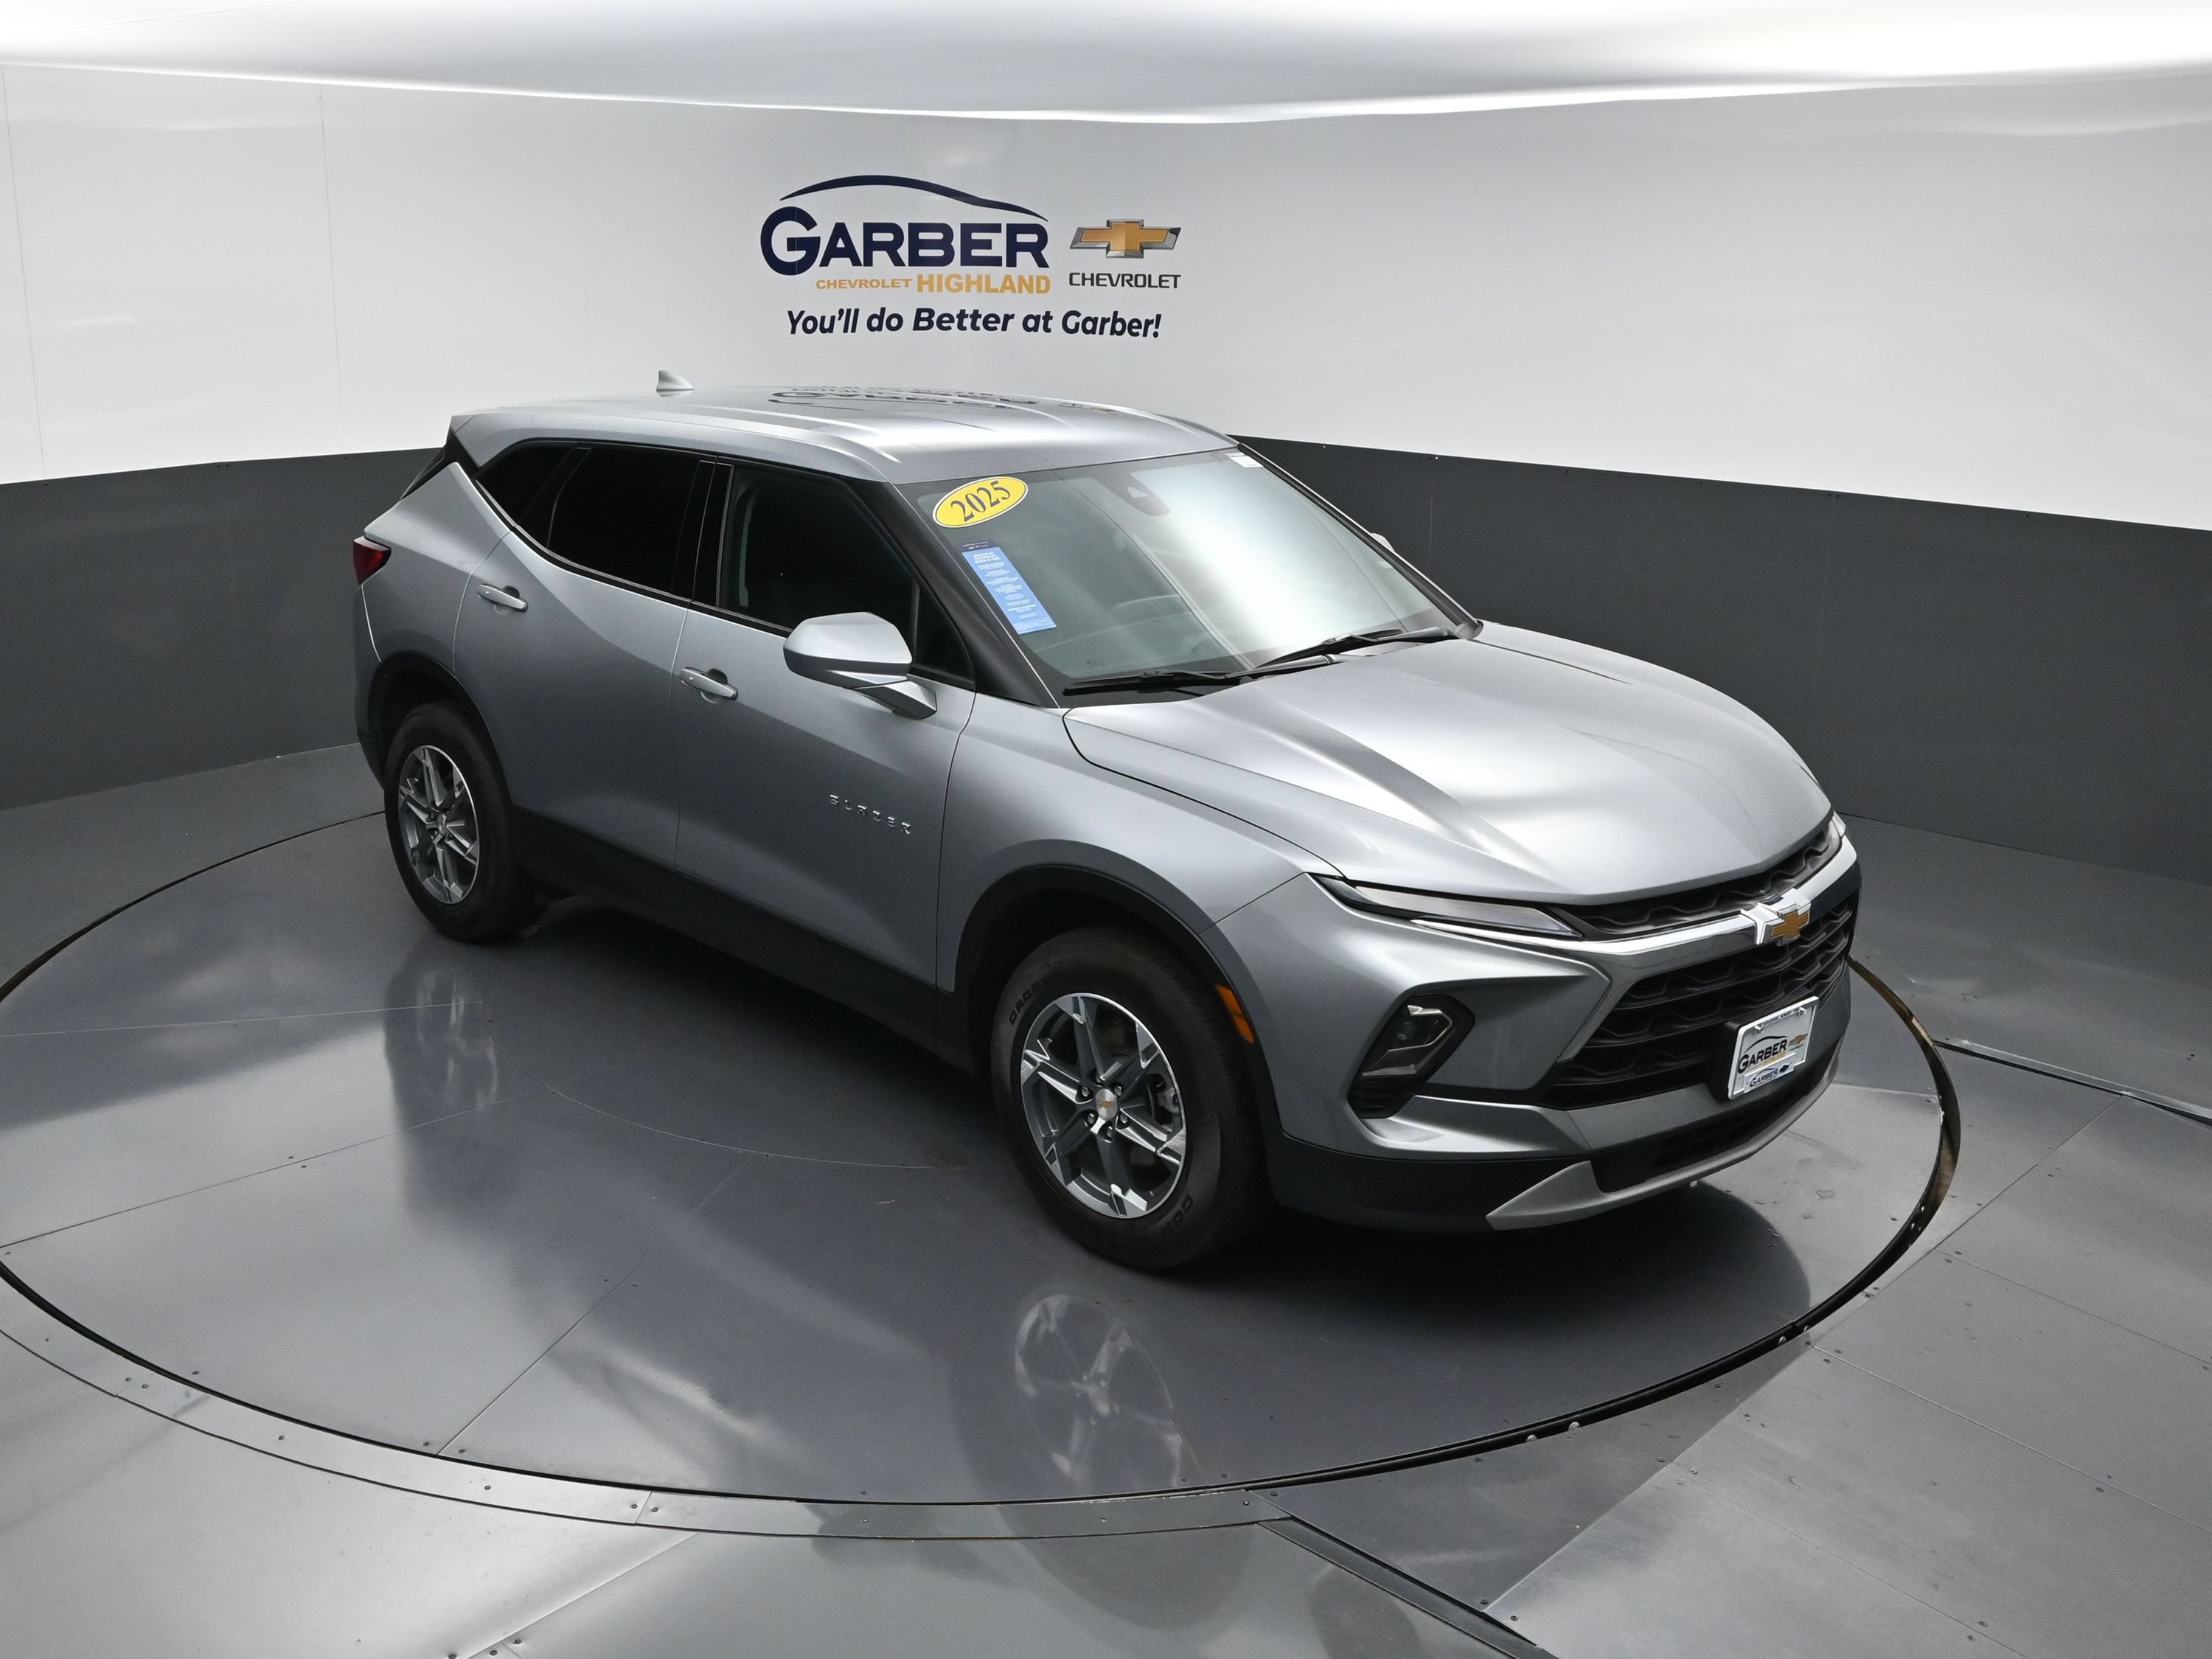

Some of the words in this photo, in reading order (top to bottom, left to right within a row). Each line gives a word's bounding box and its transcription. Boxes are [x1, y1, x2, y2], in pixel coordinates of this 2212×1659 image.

[760, 206, 1050, 276] GARBER
[815, 277, 913, 290] CHEVROLET
[917, 273, 1051, 294] HIGHLAND
[1068, 272, 1182, 289] CHEVROLET
[787, 307, 860, 335] You’ll
[866, 307, 904, 333] do
[912, 307, 1015, 332] Better
[1022, 310, 1054, 333] at
[1061, 310, 1162, 338] Garber!
[950, 480, 1011, 522] 2025
[830, 794, 911, 835] BLAZER
[1737, 1039, 1788, 1074] GARBER
